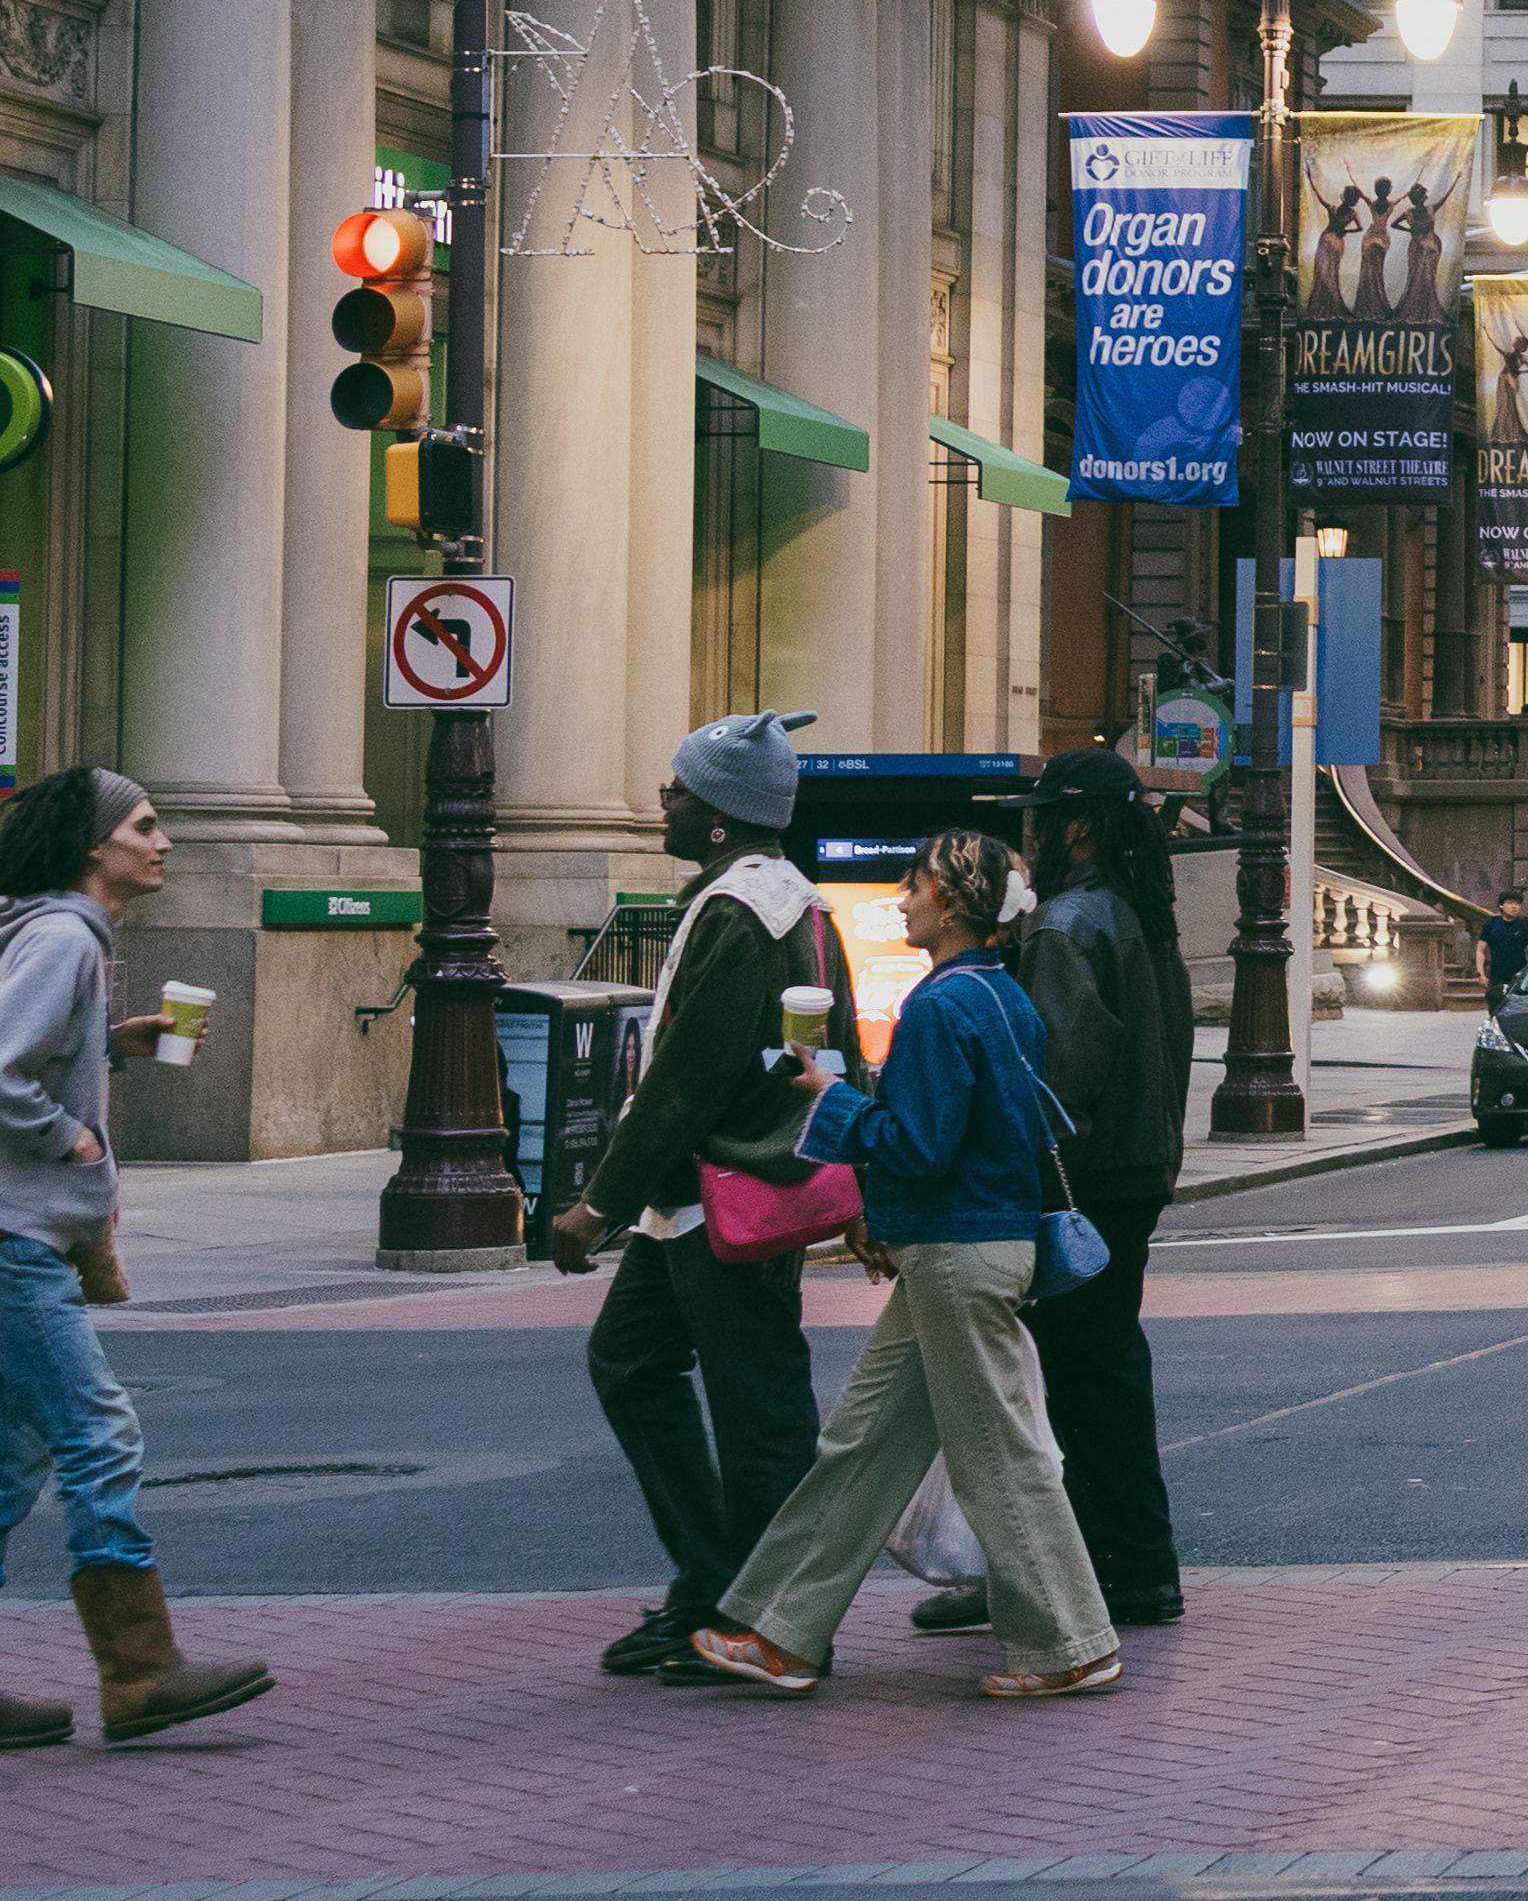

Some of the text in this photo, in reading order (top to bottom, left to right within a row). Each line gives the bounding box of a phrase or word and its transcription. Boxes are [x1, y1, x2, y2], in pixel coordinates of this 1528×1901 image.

[1124, 150, 1233, 166] GIFT LIFE
[1124, 168, 1233, 178] DONOR PROGRAM
[1083, 202, 1206, 257] Organ
[1082, 250, 1235, 296] donors
[1109, 303, 1164, 330] are
[1089, 326, 1221, 367] heroes
[1312, 382, 1451, 395] SMASH-HIT MUSICAL!
[1292, 431, 1447, 447] NOW ON STAGE!
[1079, 454, 1228, 485] donors1.org
[1356, 460, 1397, 475] STREET
[1479, 488, 1498, 498] THE
[1479, 526, 1520, 539] NOW
[816, 760, 829, 769] 32
[576, 1023, 593, 1058] W
